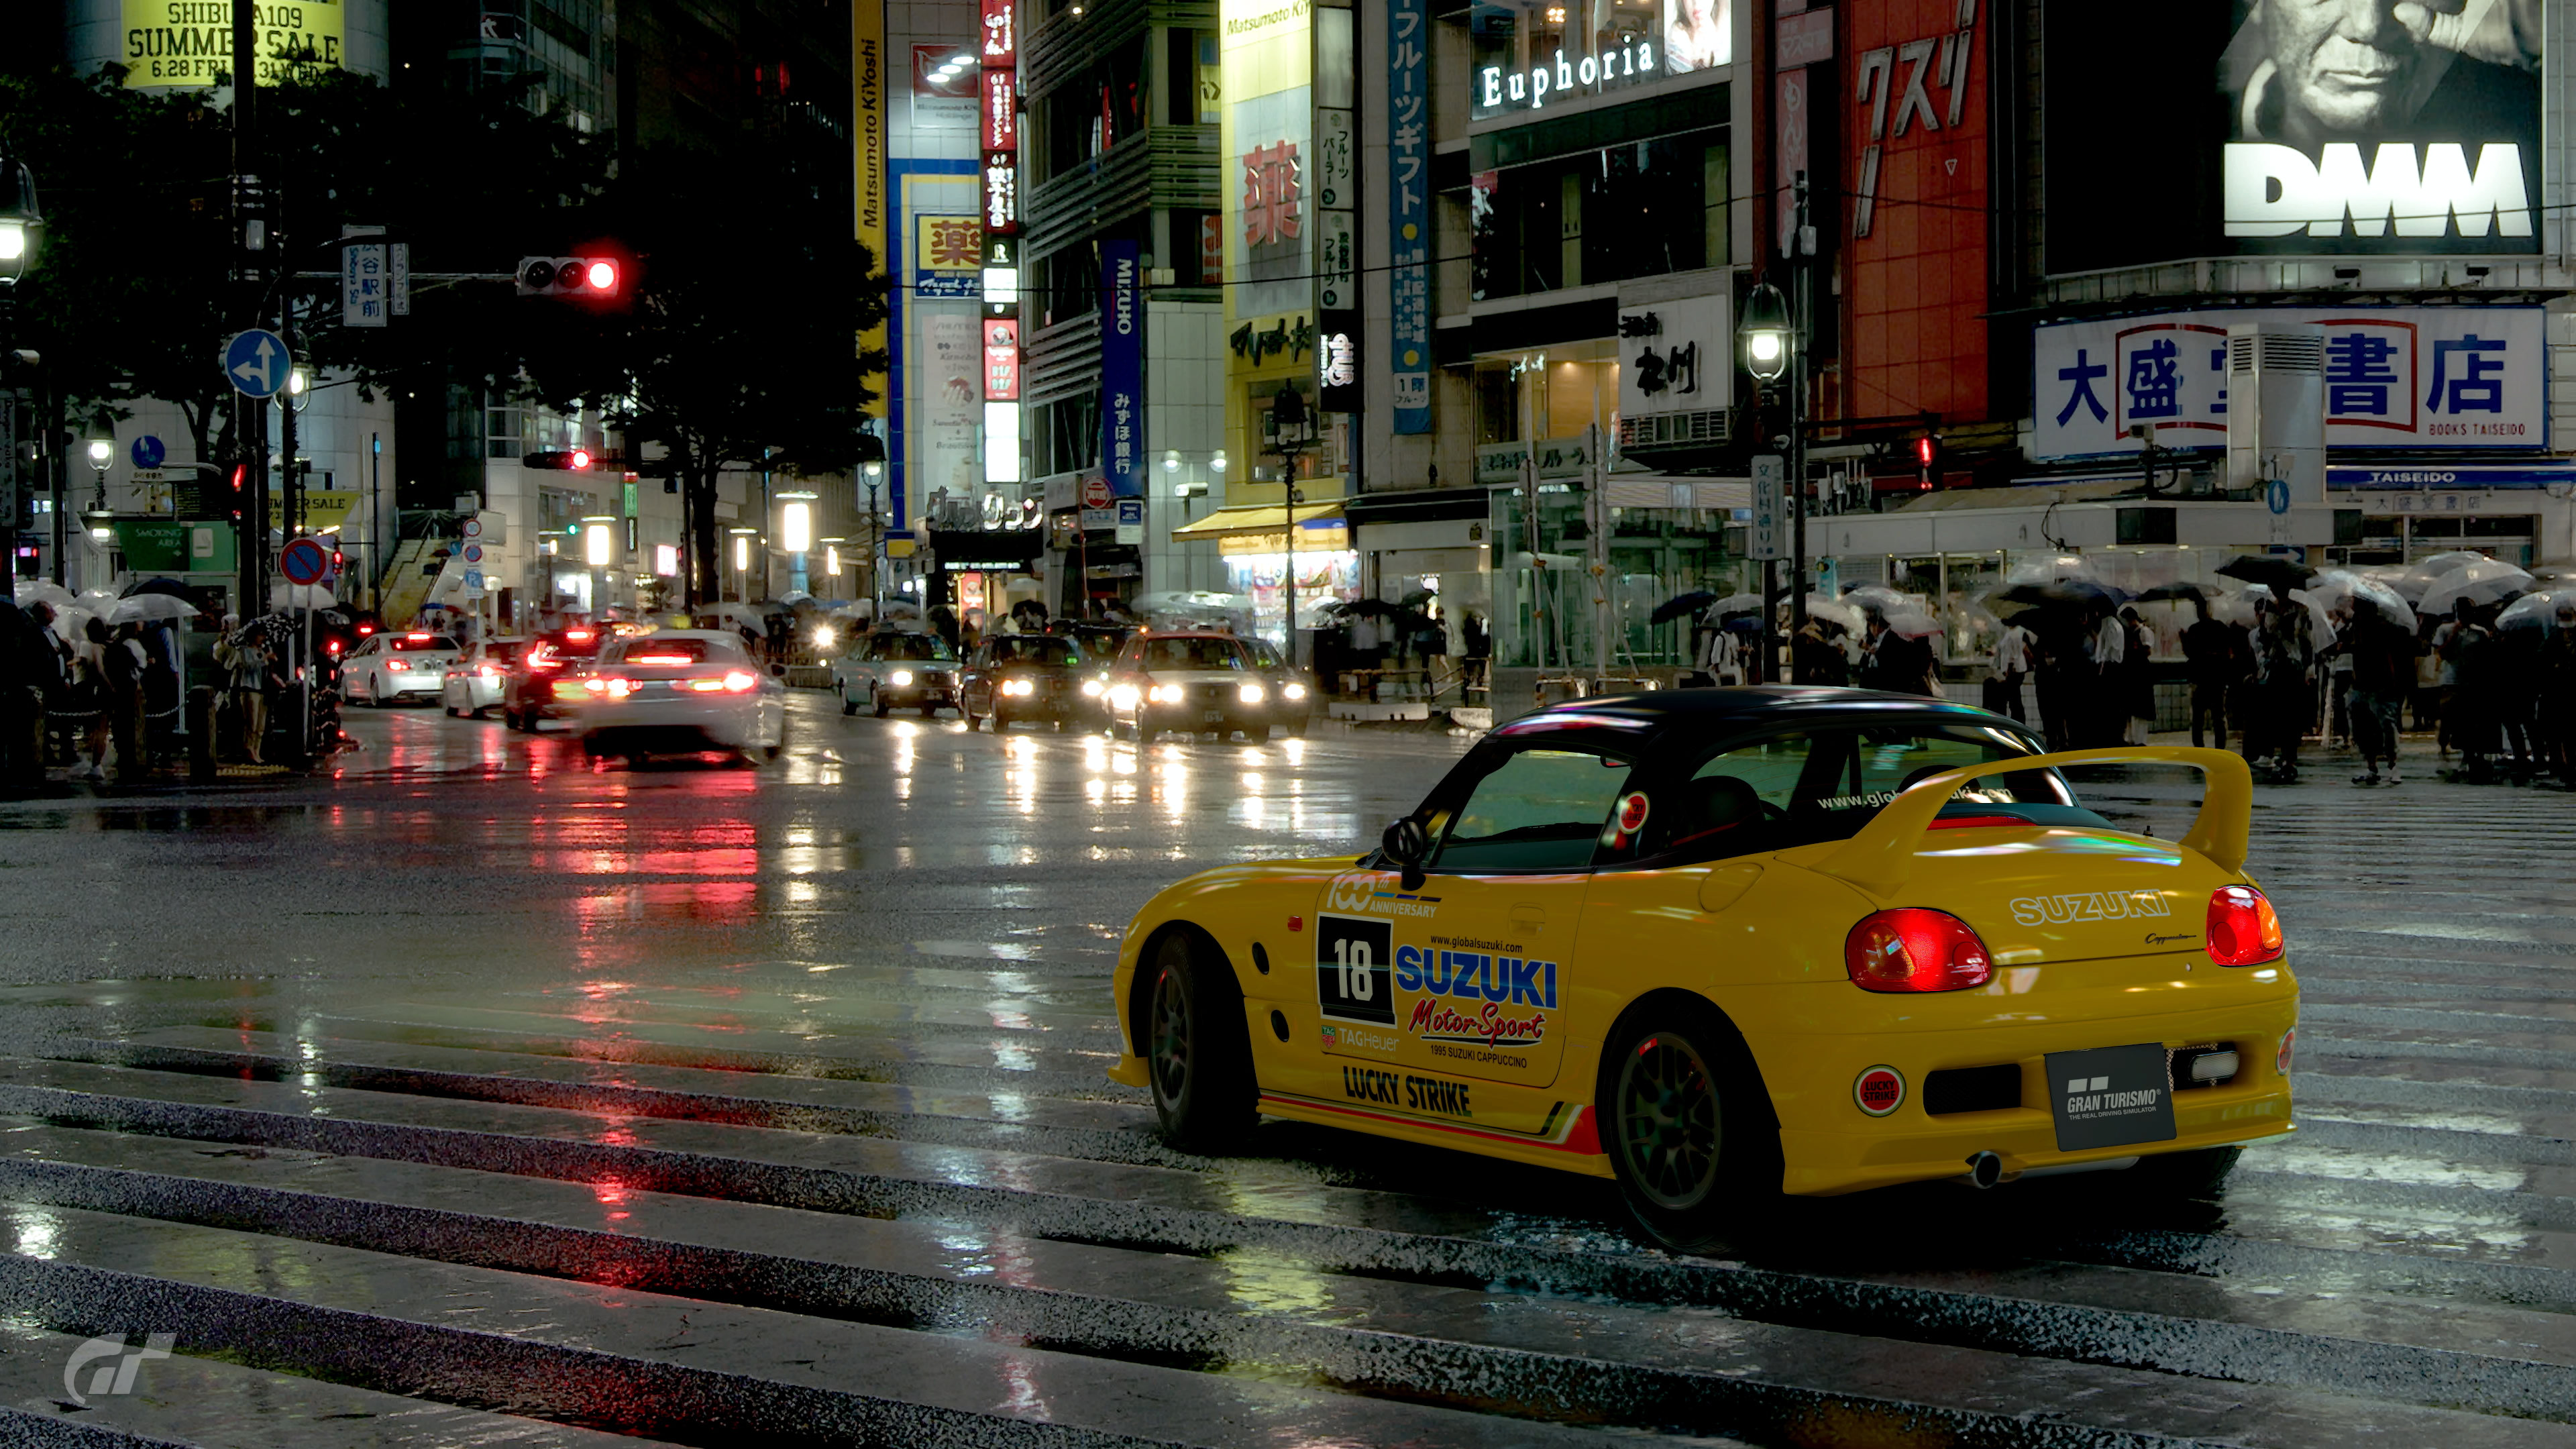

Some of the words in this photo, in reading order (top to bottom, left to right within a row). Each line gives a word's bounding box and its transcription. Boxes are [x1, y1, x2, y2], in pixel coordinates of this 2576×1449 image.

[1228, 9, 1289, 36] Matsumoto
[267, 30, 338, 65] SALE
[152, 60, 189, 77] 6.28
[1482, 36, 1654, 109] Euphoria
[1324, 138, 1335, 185] パーラー
[1338, 131, 1349, 179] フルーツ
[864, 115, 878, 228] Matsumoto
[1242, 140, 1302, 247] 薬
[2224, 142, 2534, 237] DMM
[931, 217, 981, 266] 薬
[1116, 258, 1133, 335] MIZUHO
[1114, 393, 1131, 474] みずほ銀行
[2428, 423, 2467, 436] BOOKS
[2473, 423, 2526, 436] TAISEIDO
[2371, 472, 2457, 484] TAISEIDO
[313, 498, 347, 510] SALE
[135, 529, 182, 537] SMOKING
[1817, 786, 2013, 809] www.globuki.com
[1369, 900, 1438, 918] ANNIVERSARY
[2009, 888, 2171, 926] SUZUKI
[1431, 935, 1523, 953] www.globalsuzuki.com
[1334, 938, 1374, 1002] 18
[1395, 944, 1558, 1011] SUZUKI
[1322, 1026, 1336, 1036] TAG
[1431, 1044, 1446, 1056] 1995
[1448, 1046, 1475, 1060] SUZUKI
[1477, 1051, 1527, 1069] CAPPUCCINO
[1343, 1065, 1399, 1106] LUCKY
[1405, 1075, 1472, 1118] STRIKE
[1864, 1090, 1896, 1102] STRIKE
[1865, 1080, 1895, 1091] LUCKY
[2068, 1094, 2101, 1114] GRAN
[2082, 1112, 2098, 1120] REAL
[2098, 1110, 2122, 1118] DRIVING
[2123, 1106, 2157, 1115] SIMULATOR
